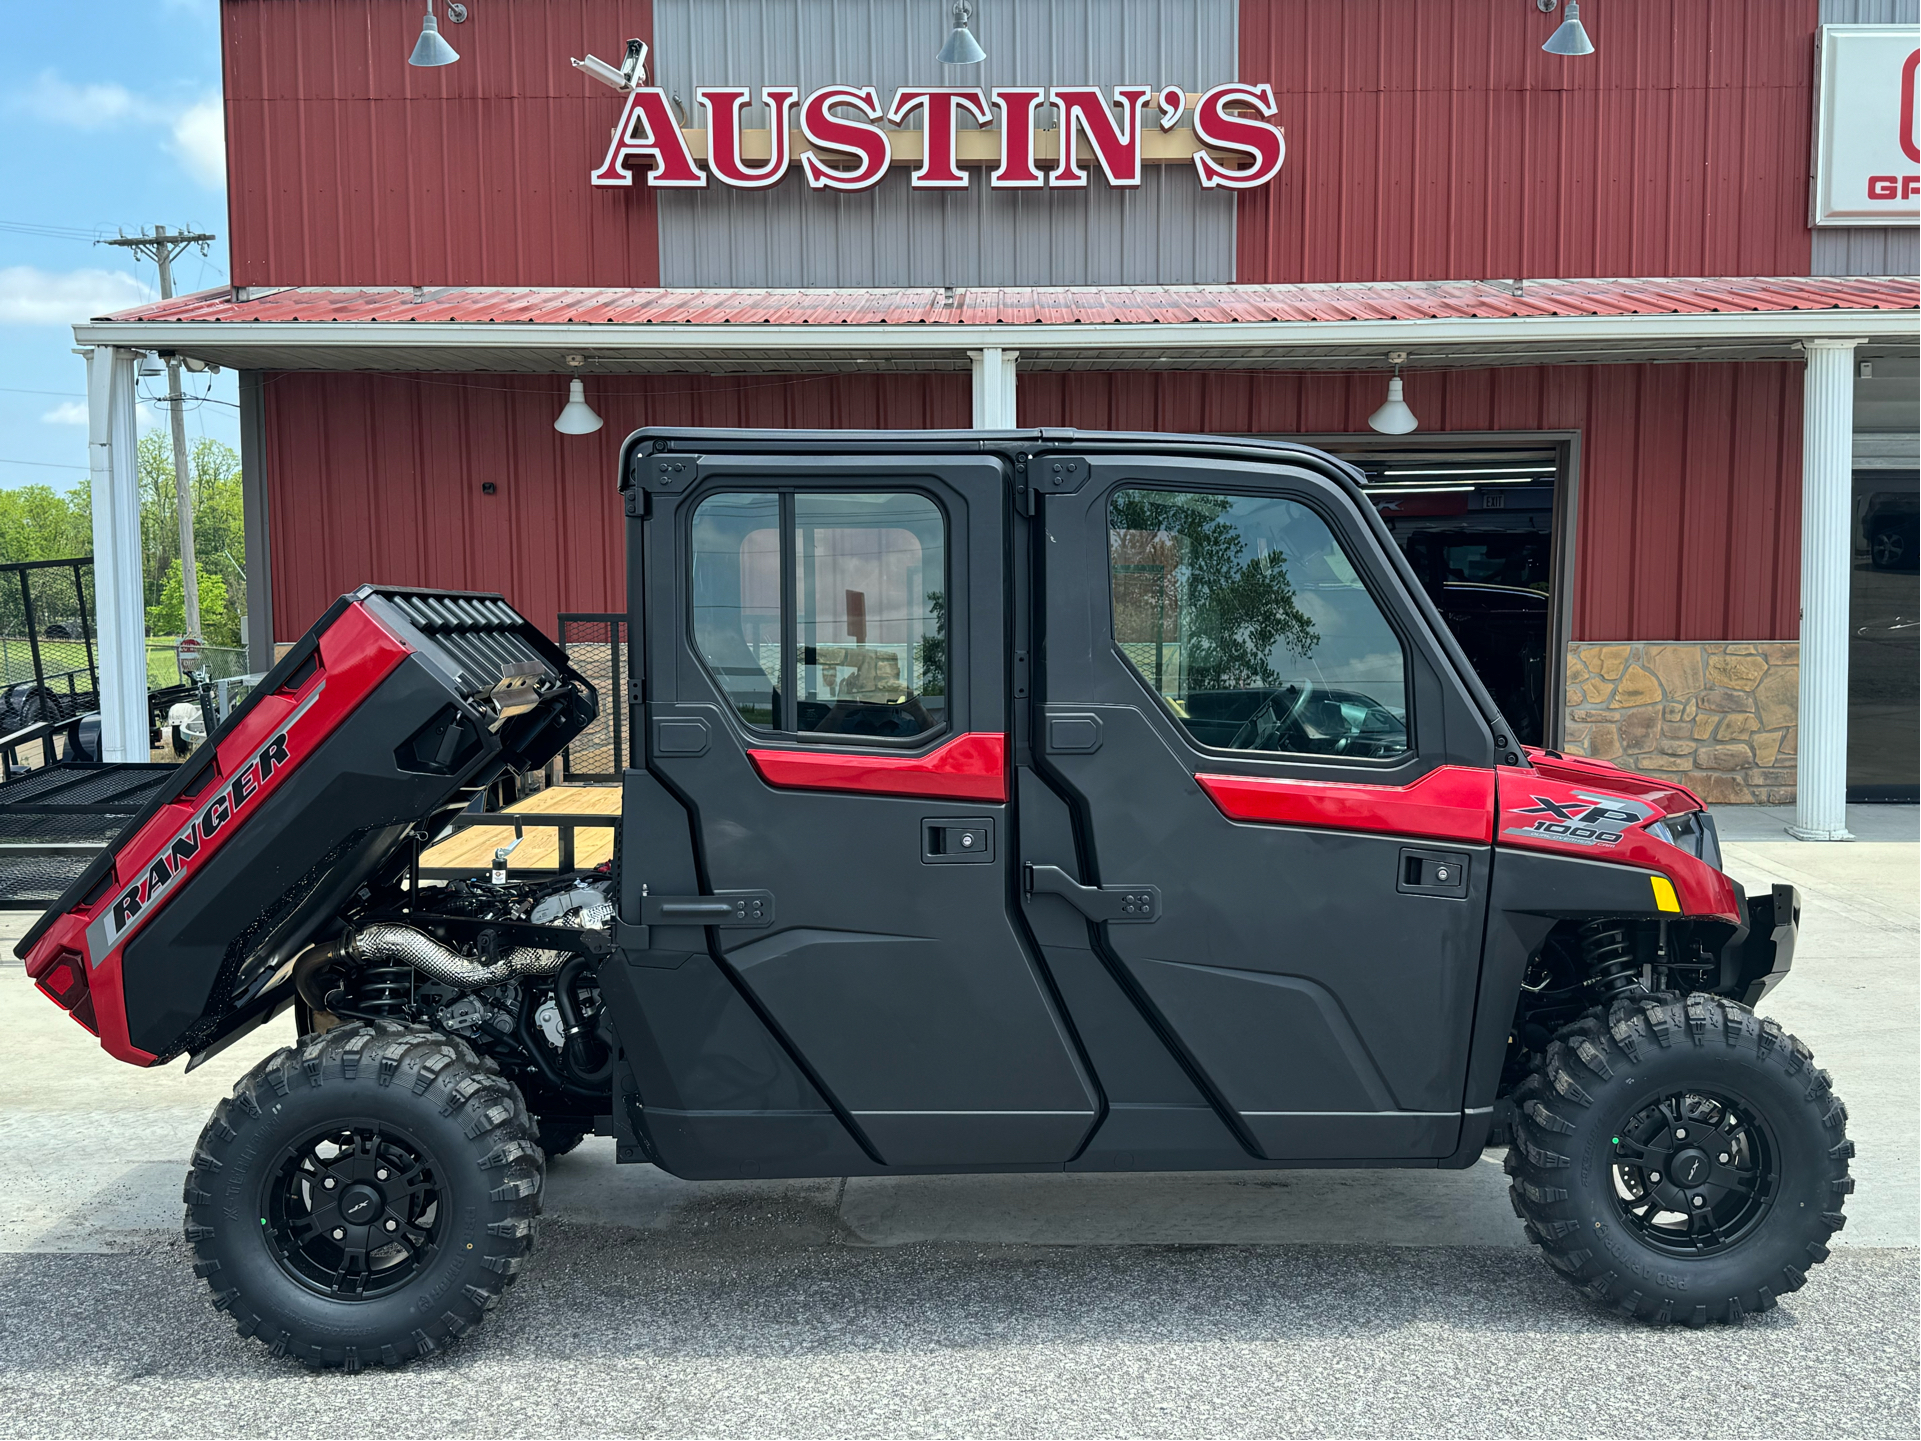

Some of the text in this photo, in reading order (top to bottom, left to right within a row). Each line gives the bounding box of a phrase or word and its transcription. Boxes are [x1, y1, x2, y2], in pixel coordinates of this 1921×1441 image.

[591, 82, 1286, 192] AUSTIN'S
[1486, 496, 1503, 508] EXIT
[1506, 794, 1643, 825] XP
[112, 732, 291, 935] RANGER
[1532, 820, 1625, 844] 1000
[1603, 1238, 1689, 1291] PRO ARMOR
